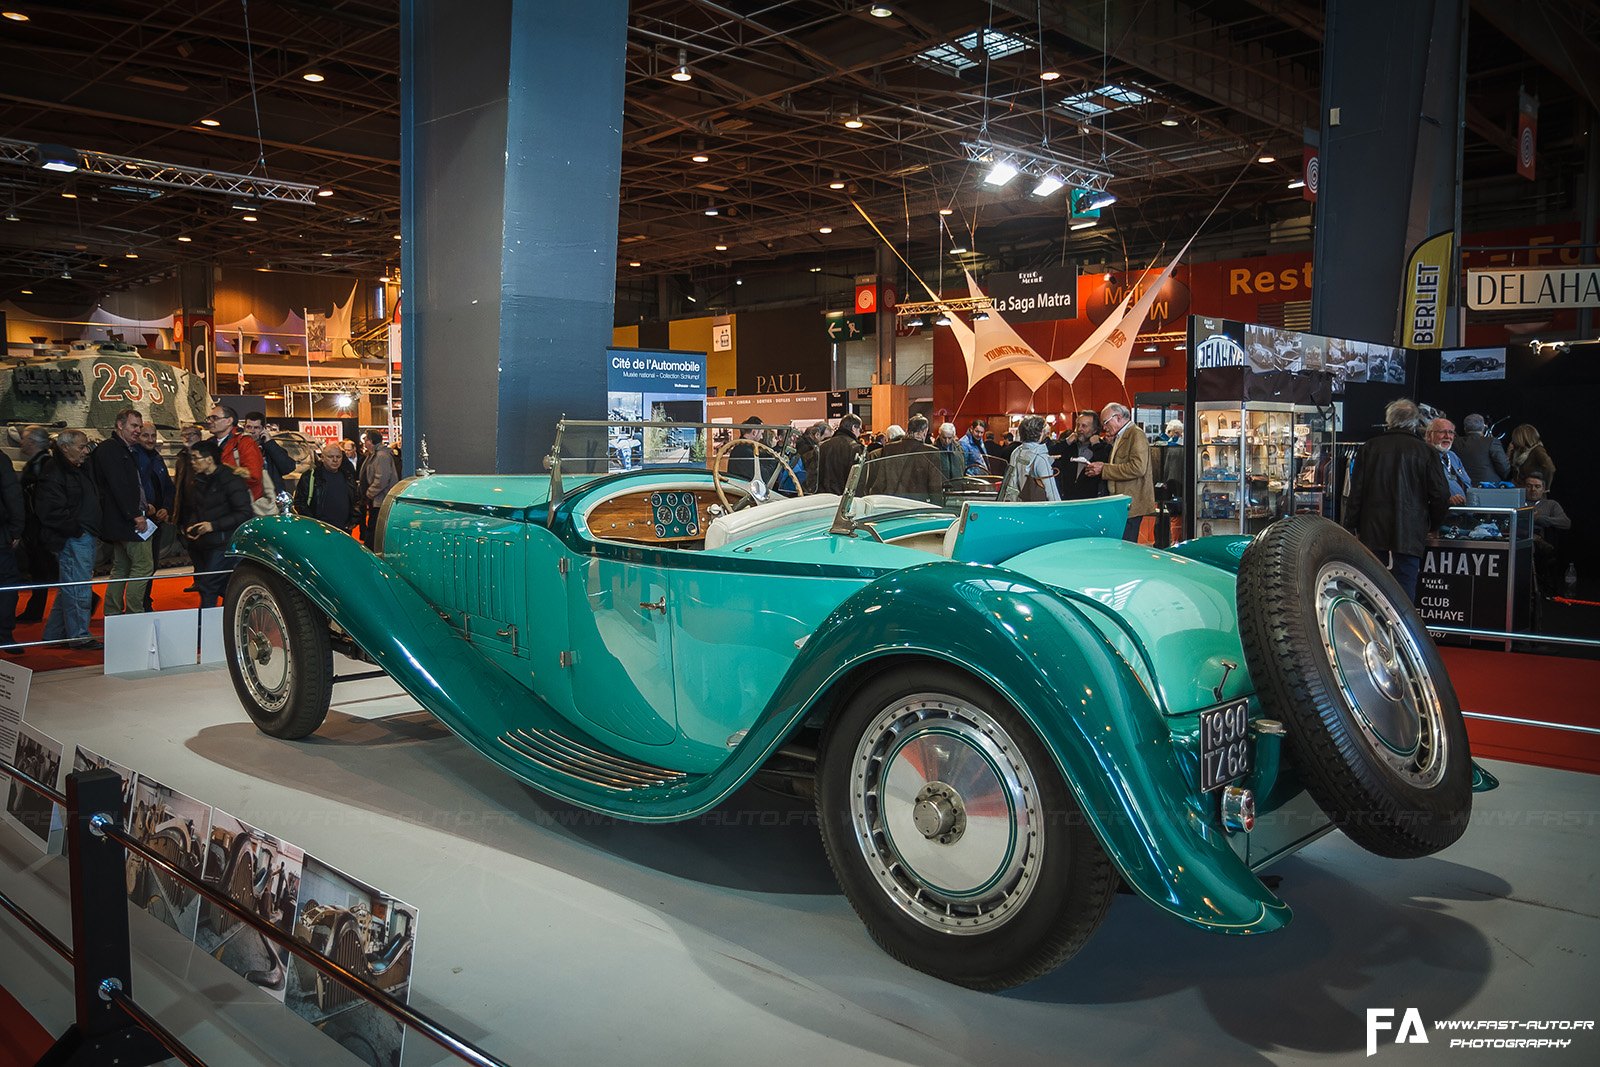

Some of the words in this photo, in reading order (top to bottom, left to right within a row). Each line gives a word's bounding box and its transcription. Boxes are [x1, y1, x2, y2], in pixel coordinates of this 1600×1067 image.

[1477, 272, 1600, 305] DELAHA
[994, 297, 1006, 312] La
[1008, 296, 1035, 313] Saga
[1037, 292, 1071, 308] Matra
[1413, 261, 1440, 345] BERLIET
[612, 357, 631, 369] Cité
[632, 358, 645, 369] de
[646, 359, 700, 372] l'Automobile
[93, 363, 163, 404] 233
[756, 373, 806, 394] PAUL
[1420, 596, 1450, 607] CLUB
[1206, 704, 1246, 750] 1990
